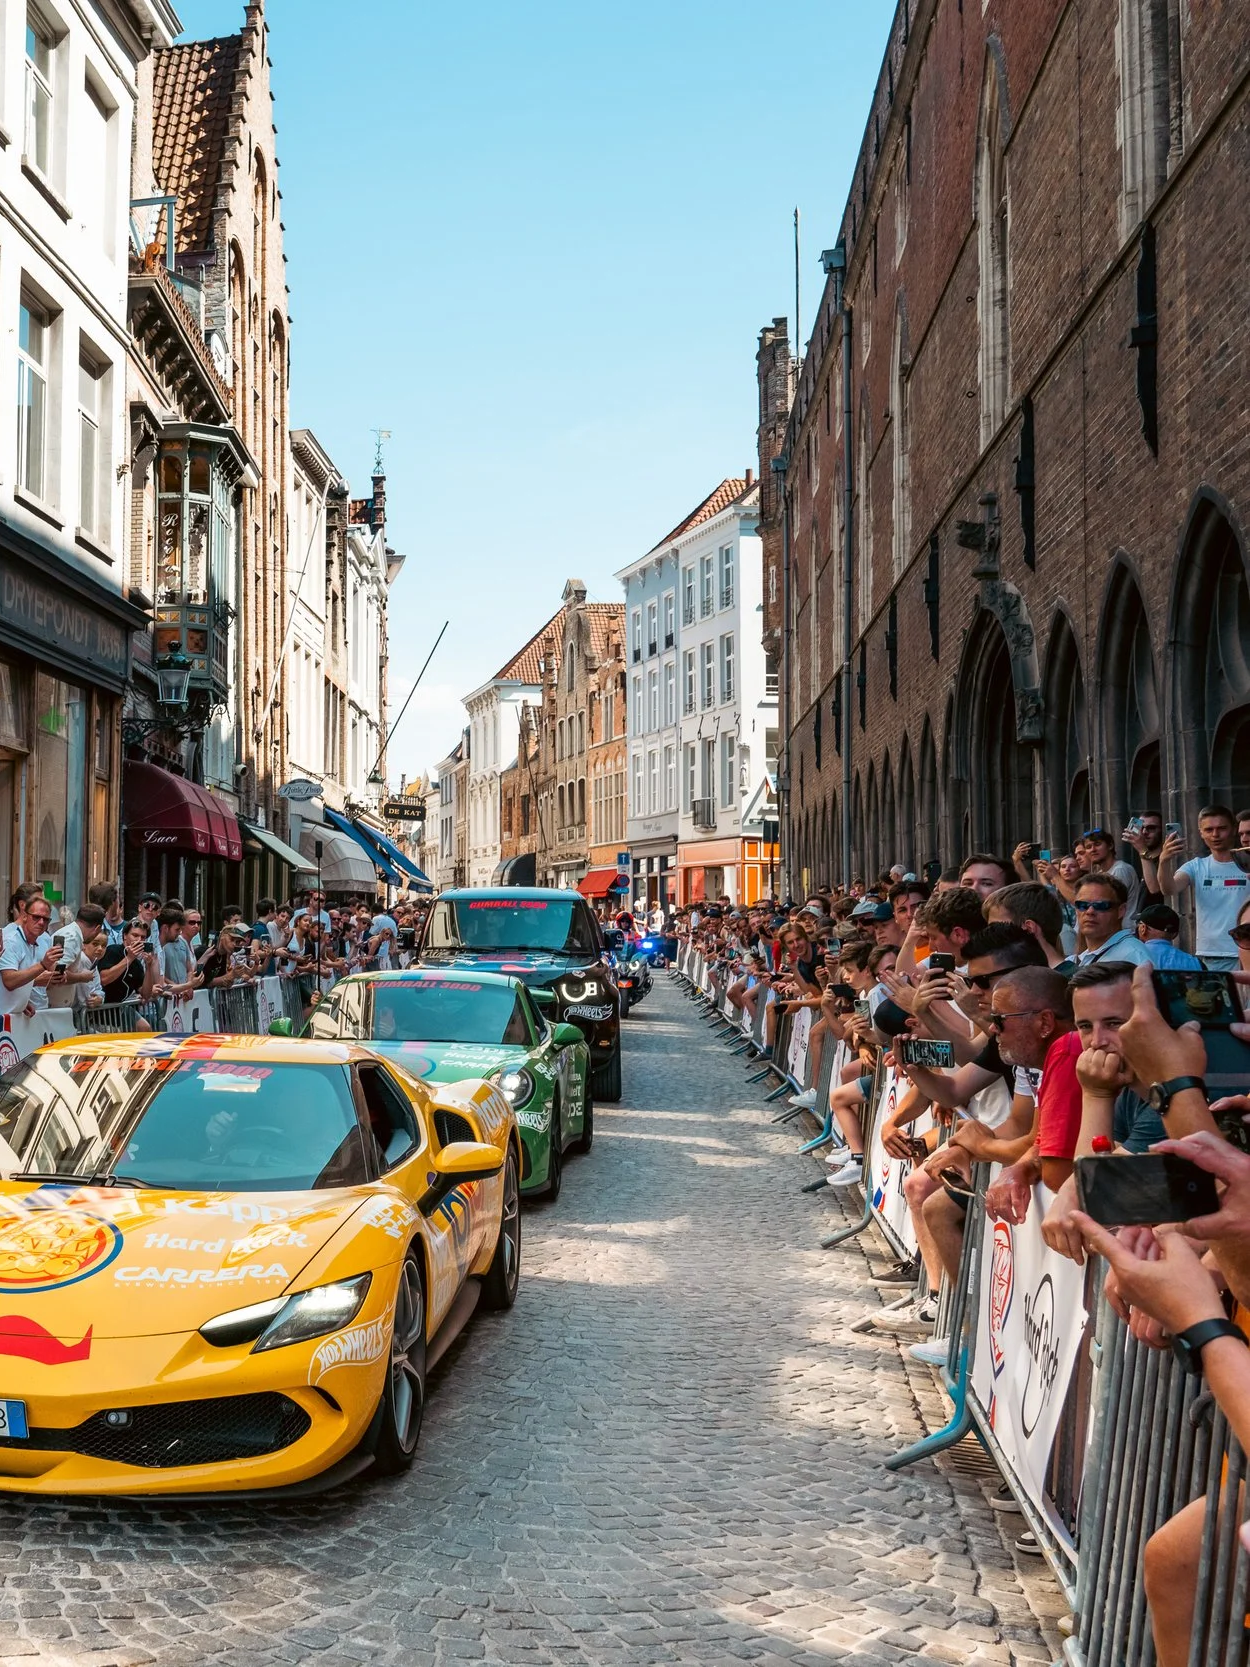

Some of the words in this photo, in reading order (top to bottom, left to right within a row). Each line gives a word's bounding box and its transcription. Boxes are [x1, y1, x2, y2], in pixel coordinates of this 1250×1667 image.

[388, 807, 400, 815] DE
[403, 809, 422, 817] KAT
[142, 829, 178, 844] Lace
[469, 900, 518, 910] GUMBALL
[366, 980, 437, 988] GUMBALL
[439, 981, 483, 992] 3000
[71, 1058, 196, 1073] GUMBALL
[197, 1062, 273, 1080] 3000
[144, 1232, 226, 1254] Hard
[229, 1229, 309, 1254] Rock
[114, 1263, 290, 1283] CARRERA
[1023, 1292, 1046, 1364] Hard
[1039, 1318, 1061, 1393] Rock
[316, 1342, 341, 1374] HOT
